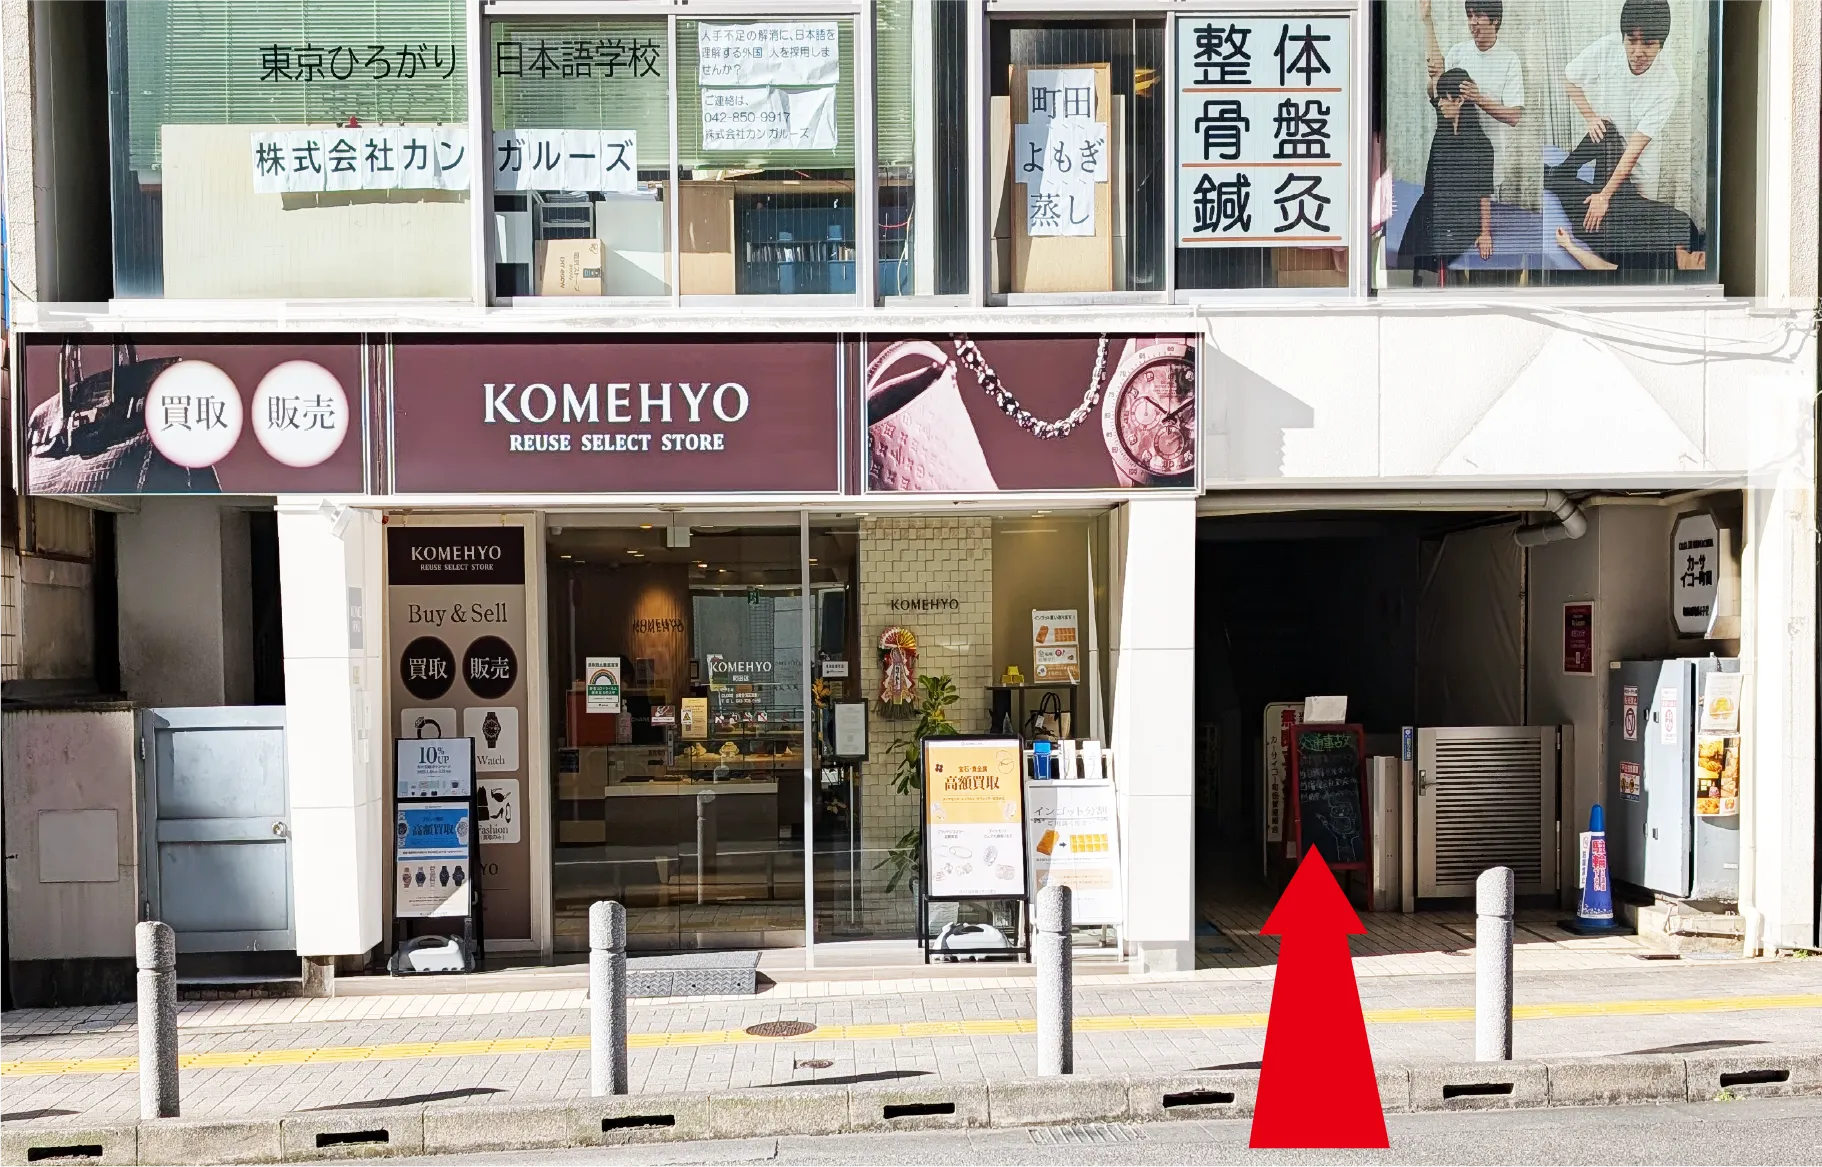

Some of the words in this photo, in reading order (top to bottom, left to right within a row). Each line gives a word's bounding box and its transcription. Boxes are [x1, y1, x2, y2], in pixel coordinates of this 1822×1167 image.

[701, 29, 836, 42] 人手不足の解消に、日本語を
[259, 44, 457, 82] 東京ひろがり
[497, 38, 662, 79] 日本語学校
[1193, 23, 1332, 87] 整体
[704, 95, 749, 106] ご連絡は、
[1031, 86, 1092, 120] 町田
[704, 112, 790, 123] 042-850-9917
[1193, 98, 1332, 161] 骨盤
[255, 138, 466, 178] 株式会社カン
[497, 138, 635, 173] ガルーズ
[1023, 138, 1105, 175] よもぎ
[1030, 193, 1090, 228] 蒸し
[1193, 172, 1332, 234] 鍼灸
[161, 394, 229, 432] 買取
[267, 394, 336, 432] 販売
[483, 382, 749, 425] KOMEHYO
[509, 433, 571, 451] REUSE
[581, 433, 652, 451] SELECT
[661, 433, 725, 451] STORE
[411, 545, 502, 561] KOMEHYO
[1687, 553, 1706, 571] カーサ
[471, 563, 494, 571] STORE
[408, 604, 447, 627] Buy
[450, 603, 467, 623] &
[471, 602, 508, 623] Sell
[891, 598, 959, 611] KOMEHYO
[409, 657, 448, 680] 買取
[470, 656, 510, 680] 販売
[711, 661, 772, 672] KOMEHYO
[477, 755, 505, 765] Watch
[944, 775, 1000, 791] 高額買取
